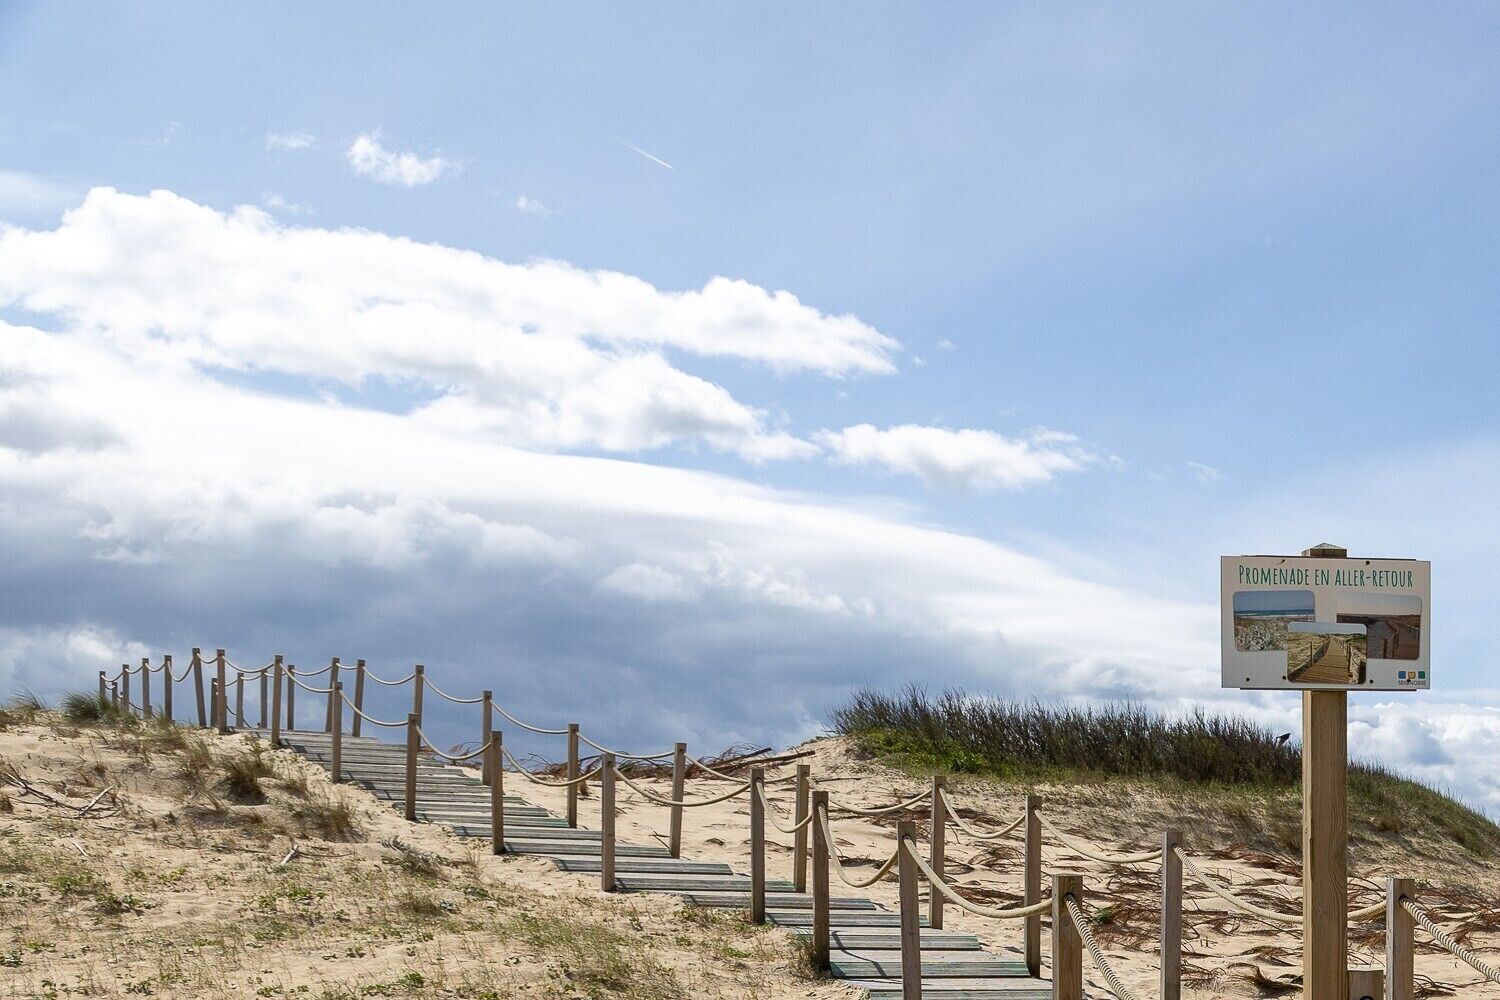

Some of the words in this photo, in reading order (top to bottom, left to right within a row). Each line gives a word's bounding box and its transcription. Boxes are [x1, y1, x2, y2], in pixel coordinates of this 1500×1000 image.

[1239, 565, 1309, 586] PROMENADE
[1315, 570, 1329, 586] EN
[1335, 569, 1413, 587] ALLER-RETOUR
